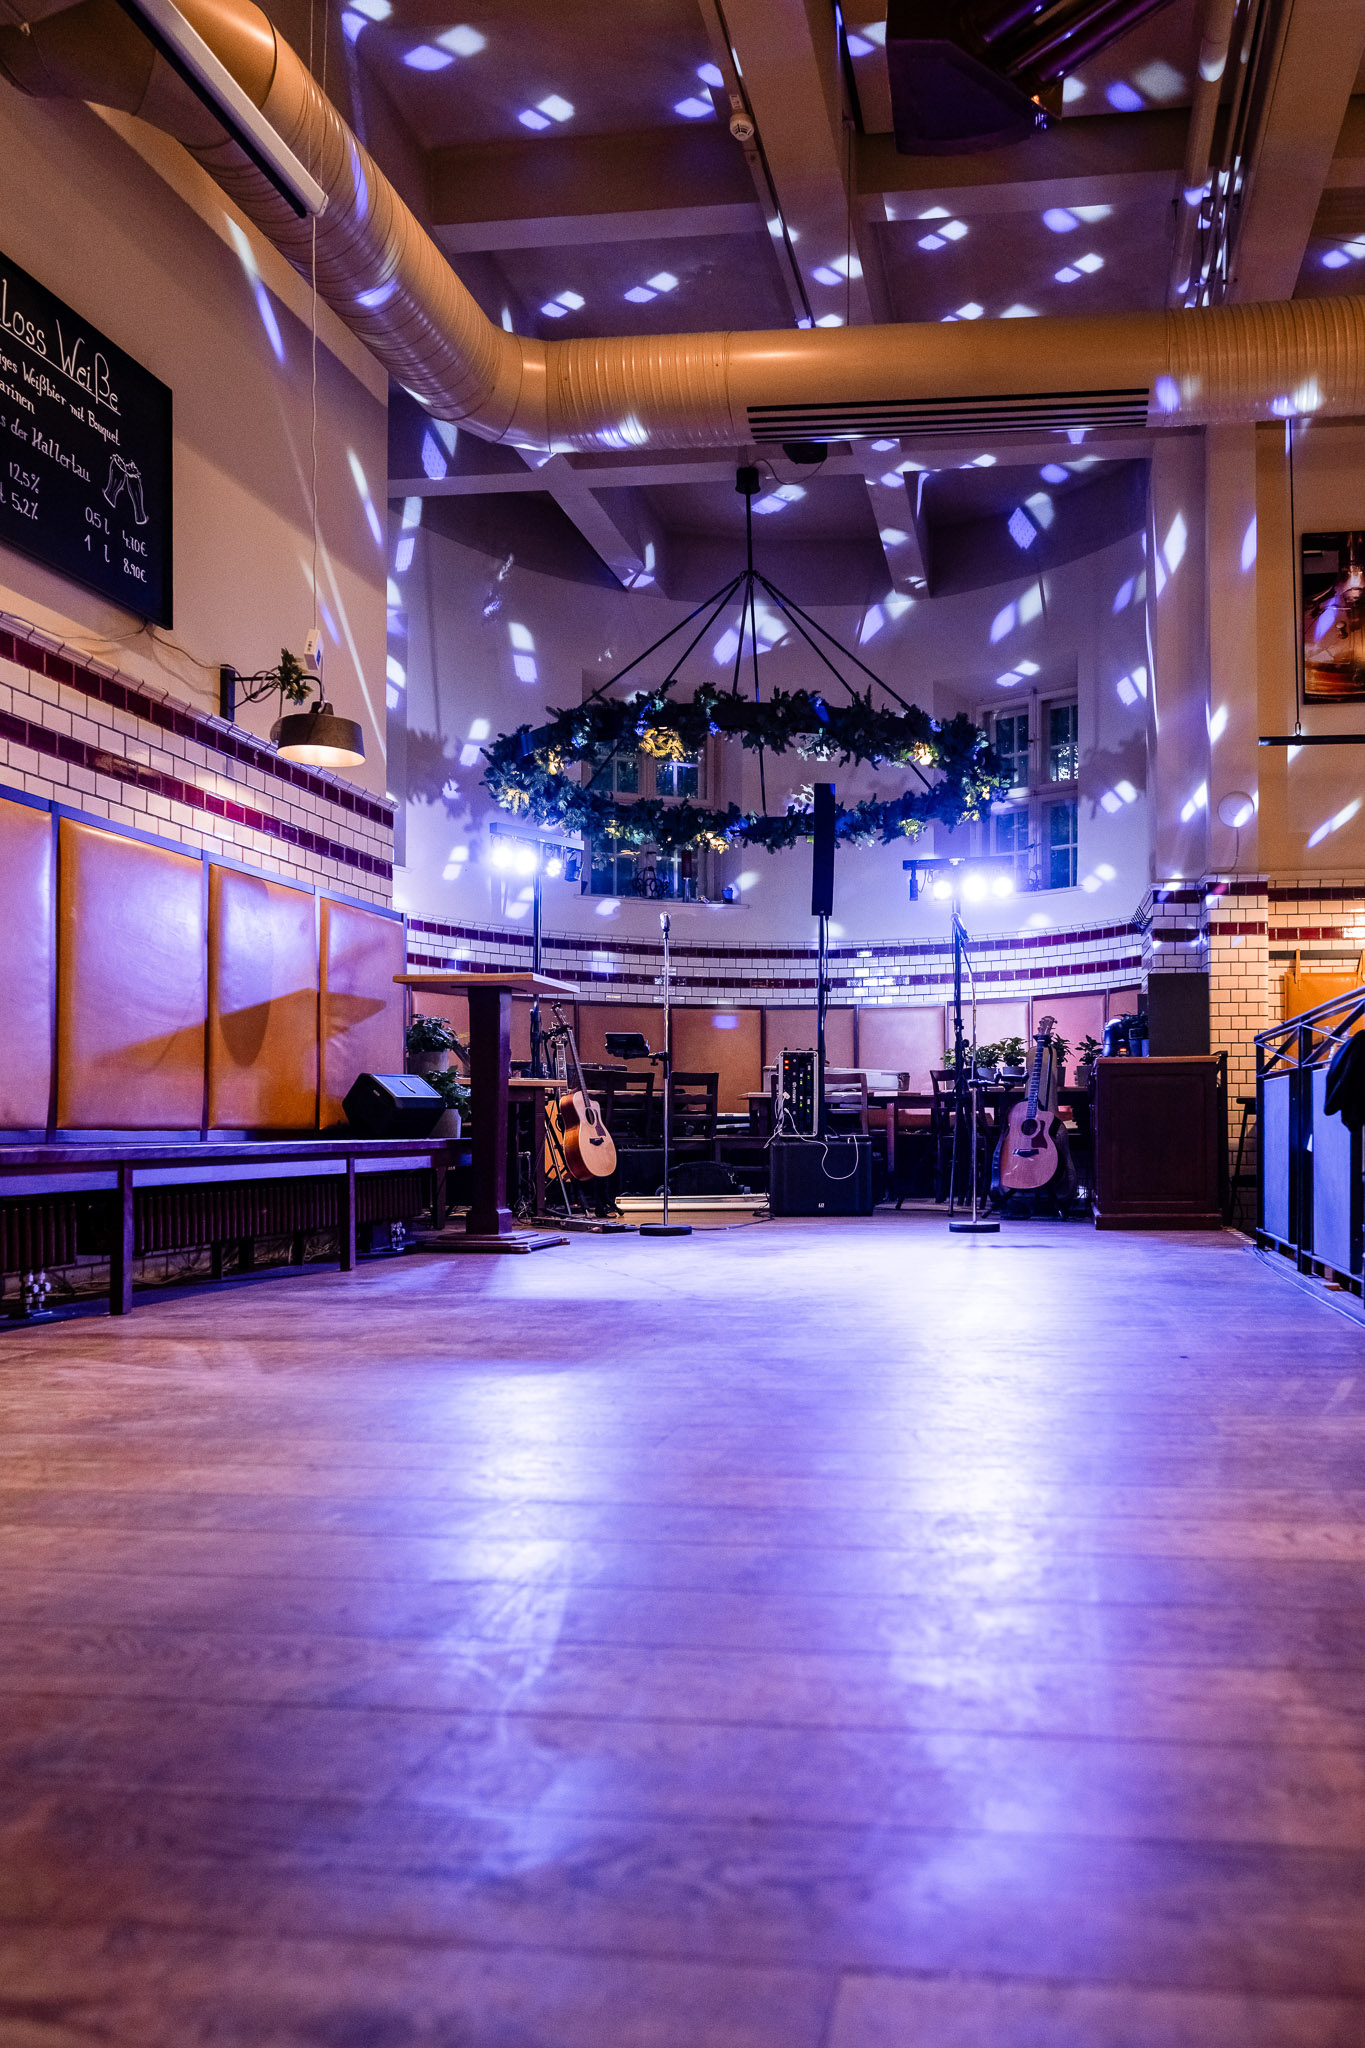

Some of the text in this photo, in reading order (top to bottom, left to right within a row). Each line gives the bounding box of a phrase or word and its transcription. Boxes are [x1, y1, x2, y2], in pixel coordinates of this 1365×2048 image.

[0, 278, 119, 412] loss Weiße
[22, 361, 67, 406] Weißbier
[69, 404, 85, 422] mit
[87, 410, 121, 446] Bouquet
[10, 418, 29, 441] der
[31, 427, 91, 482] Hallertau
[84, 534, 91, 552] 1
[123, 557, 148, 583] 8.90€
